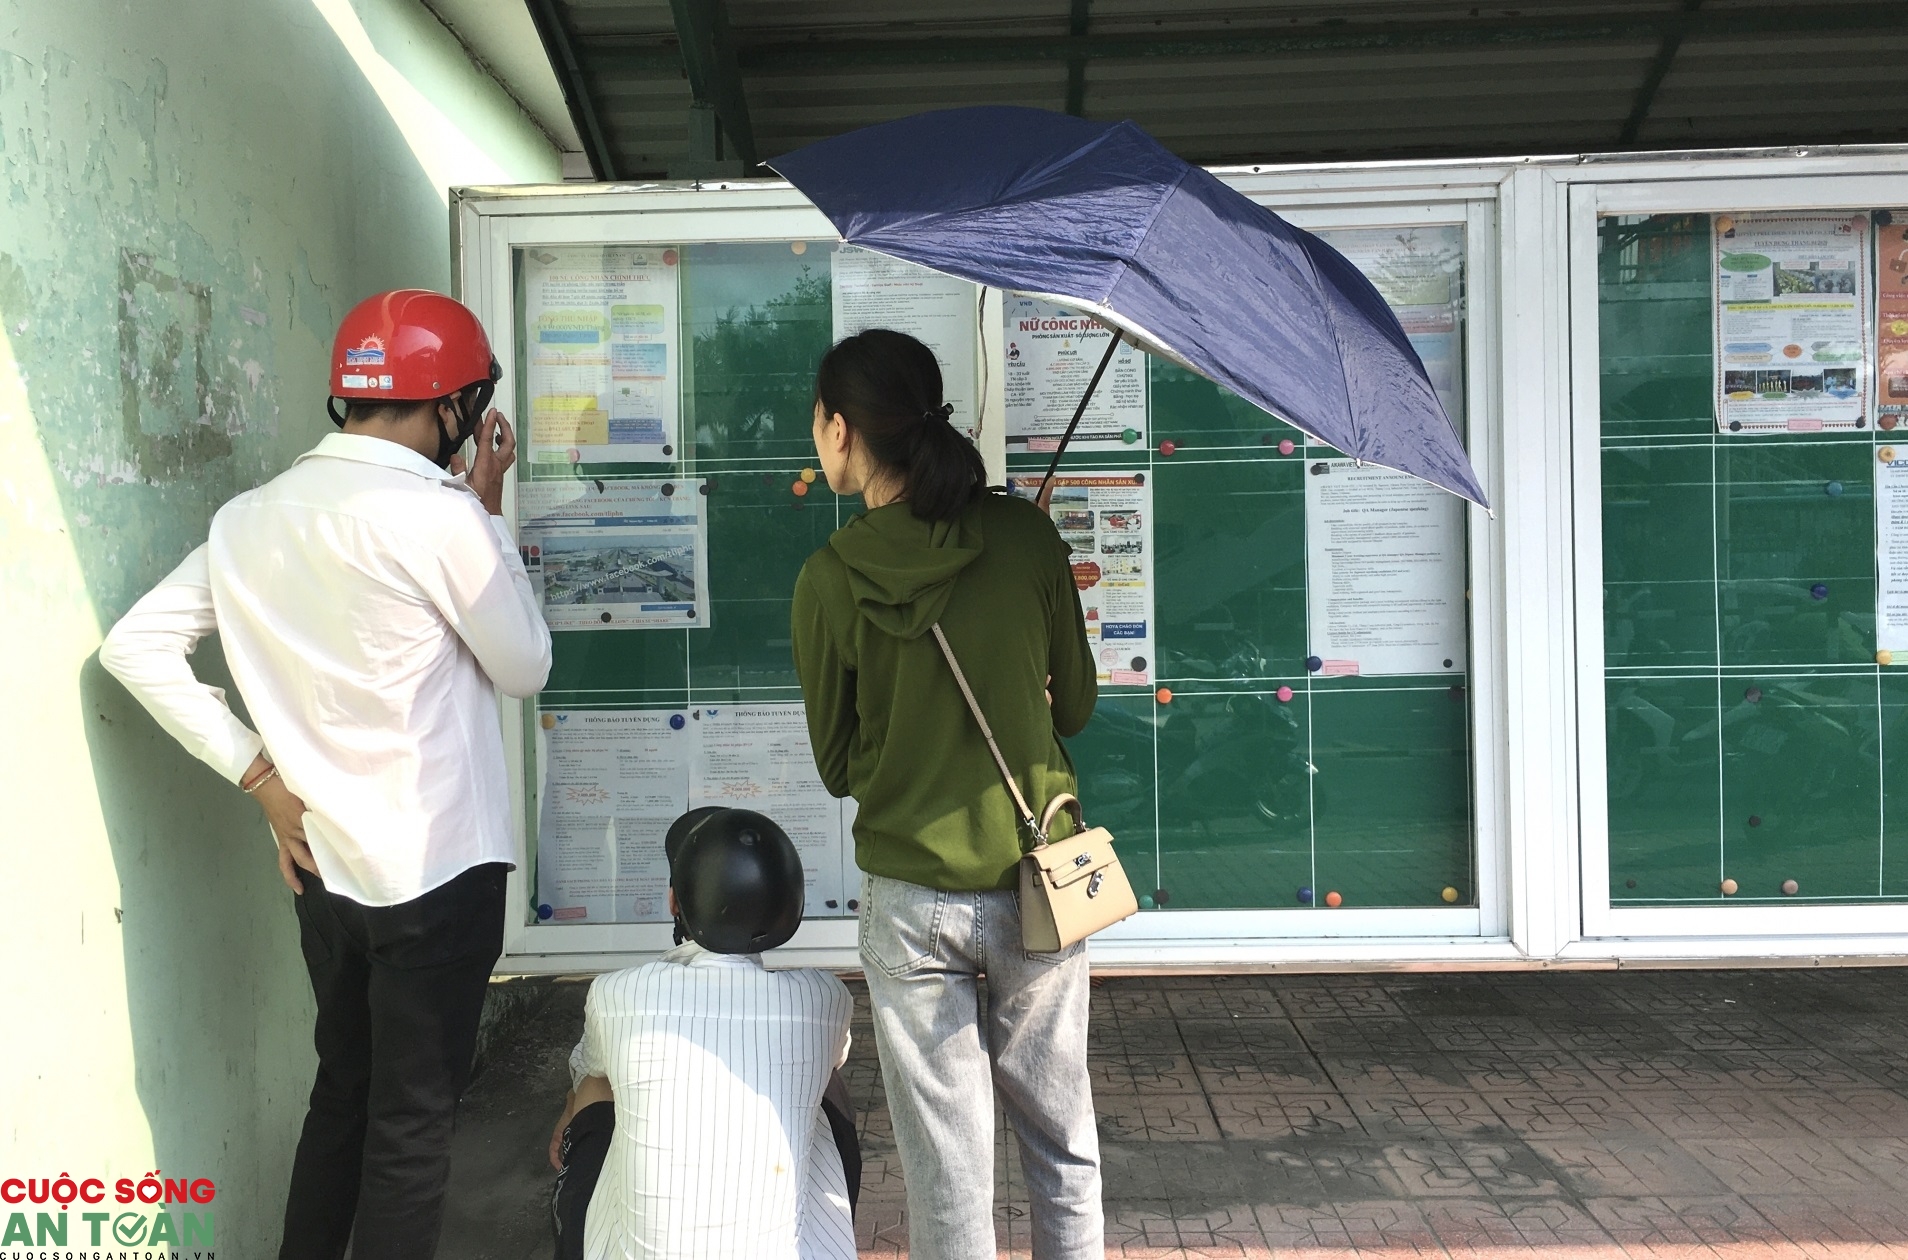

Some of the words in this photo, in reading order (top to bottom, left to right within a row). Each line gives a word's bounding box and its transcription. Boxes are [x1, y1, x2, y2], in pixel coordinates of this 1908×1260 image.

[1019, 317, 1040, 331] NỮ
[1041, 317, 1078, 331] CÔNG
[1080, 319, 1105, 330] NH
[550, 543, 695, 601] https://www.facebook.com/tliphn
